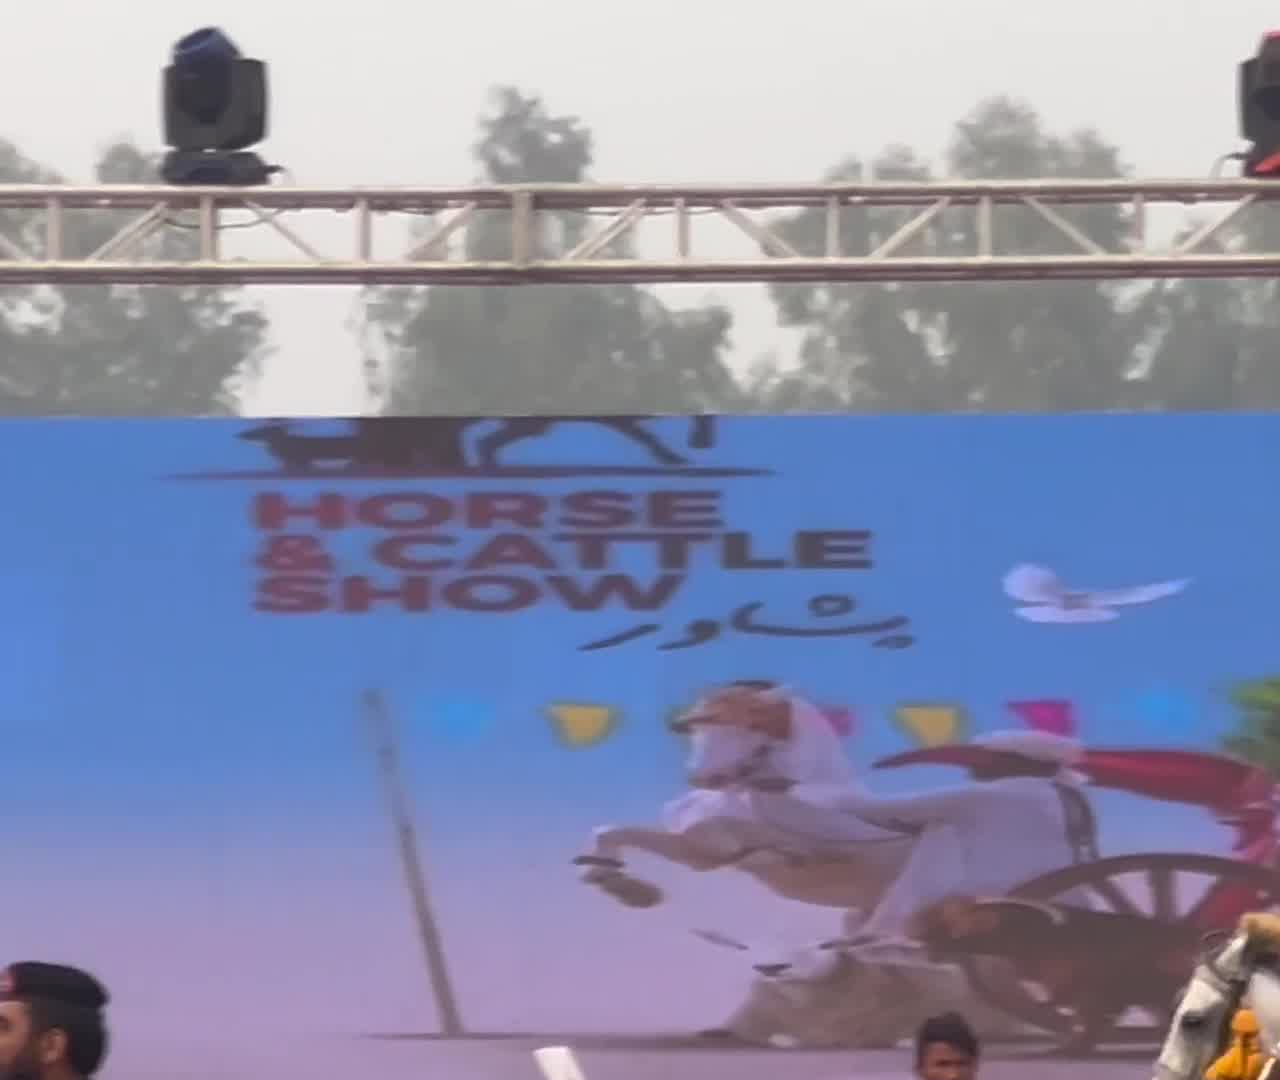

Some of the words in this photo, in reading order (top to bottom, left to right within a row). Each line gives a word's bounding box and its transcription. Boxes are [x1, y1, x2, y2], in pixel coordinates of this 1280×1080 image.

[252, 490, 723, 530] HORSE
[252, 534, 330, 571] &
[373, 531, 873, 570] CATTLE
[252, 574, 686, 613] SHOW
